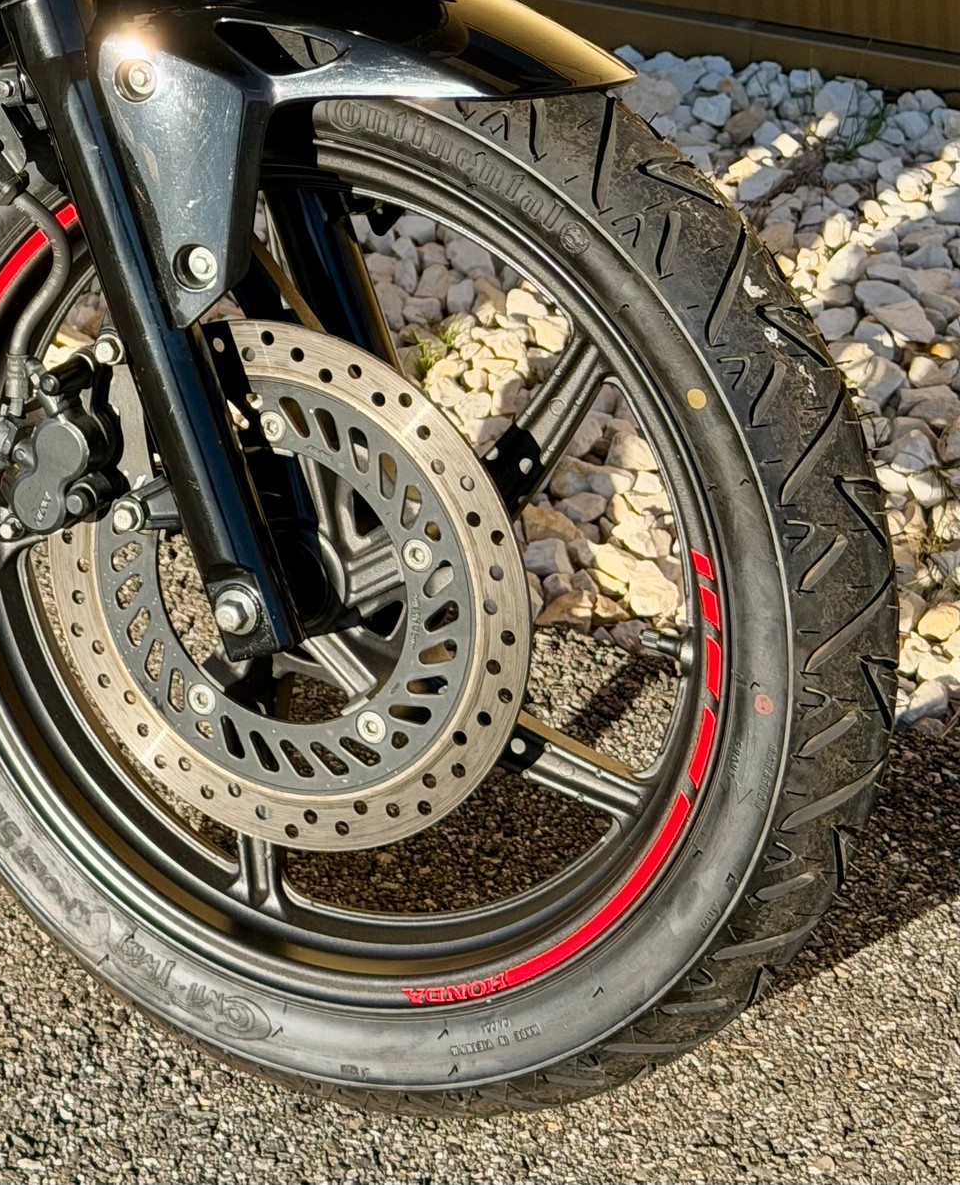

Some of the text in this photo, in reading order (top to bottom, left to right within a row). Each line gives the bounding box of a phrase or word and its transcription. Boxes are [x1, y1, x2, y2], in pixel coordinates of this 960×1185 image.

[401, 973, 508, 1004] HONDA
[497, 1034, 510, 1046] IN
[513, 1023, 541, 1042] MADE
[449, 1038, 495, 1056] VIETNAM
